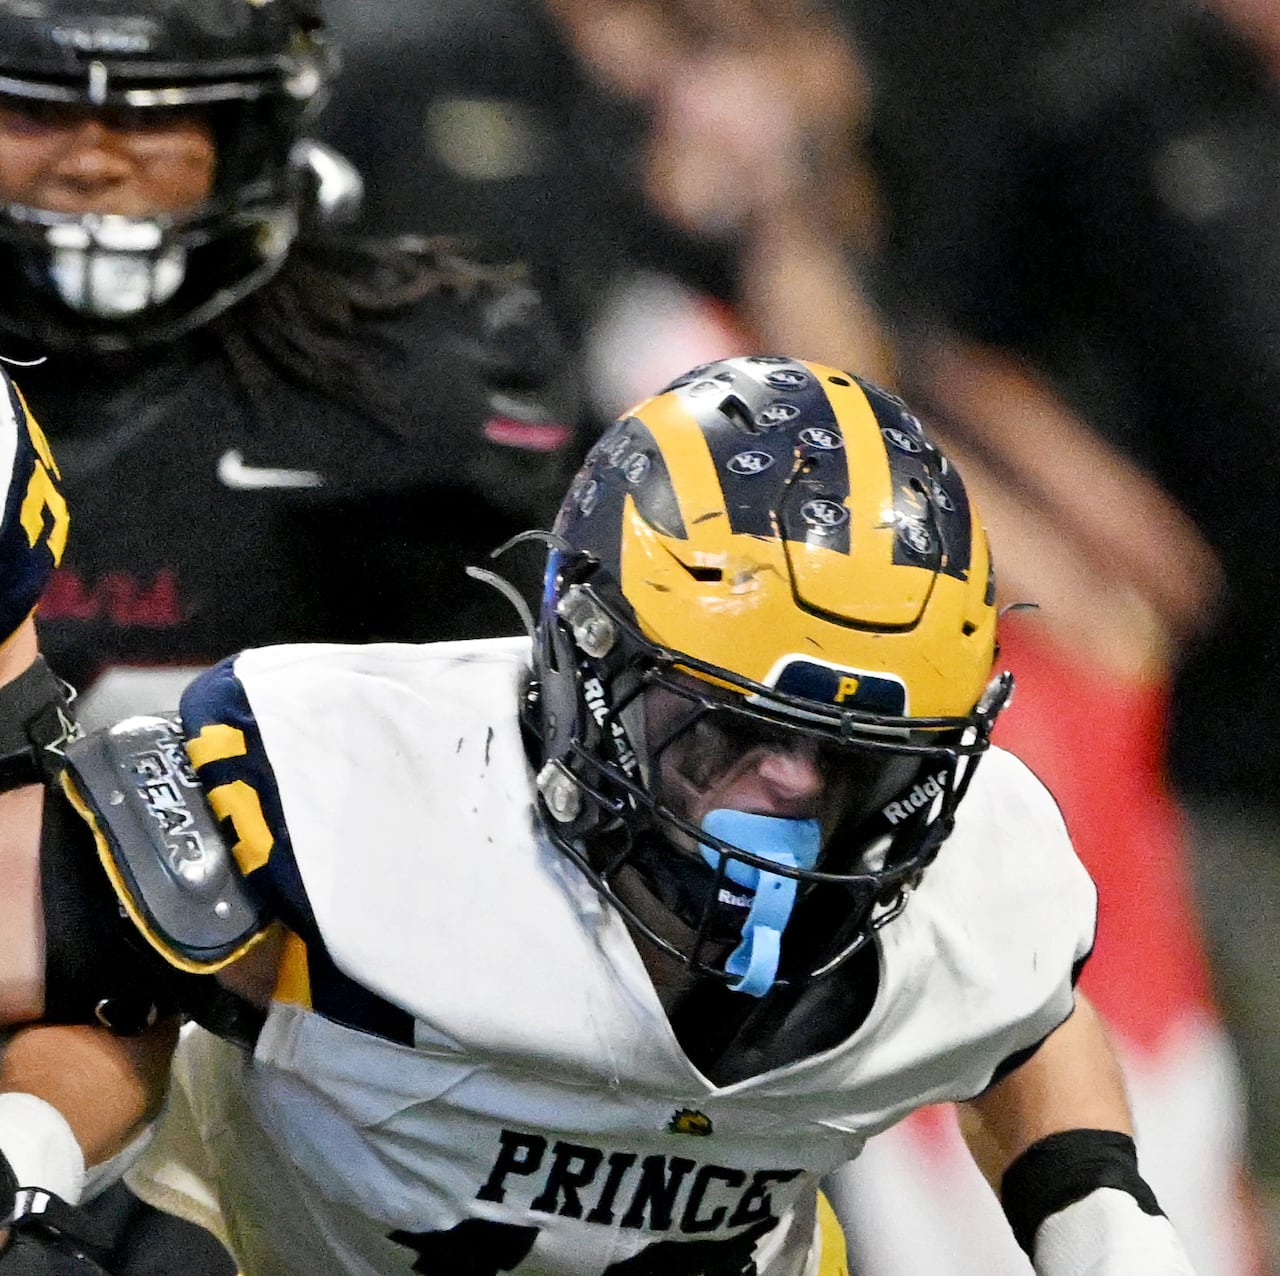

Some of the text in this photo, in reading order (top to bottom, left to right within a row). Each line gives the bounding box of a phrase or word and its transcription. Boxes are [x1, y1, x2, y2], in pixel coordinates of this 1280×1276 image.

[834, 676, 860, 703] P
[134, 750, 207, 878] GEAR
[475, 1129, 807, 1234] PRINCE
